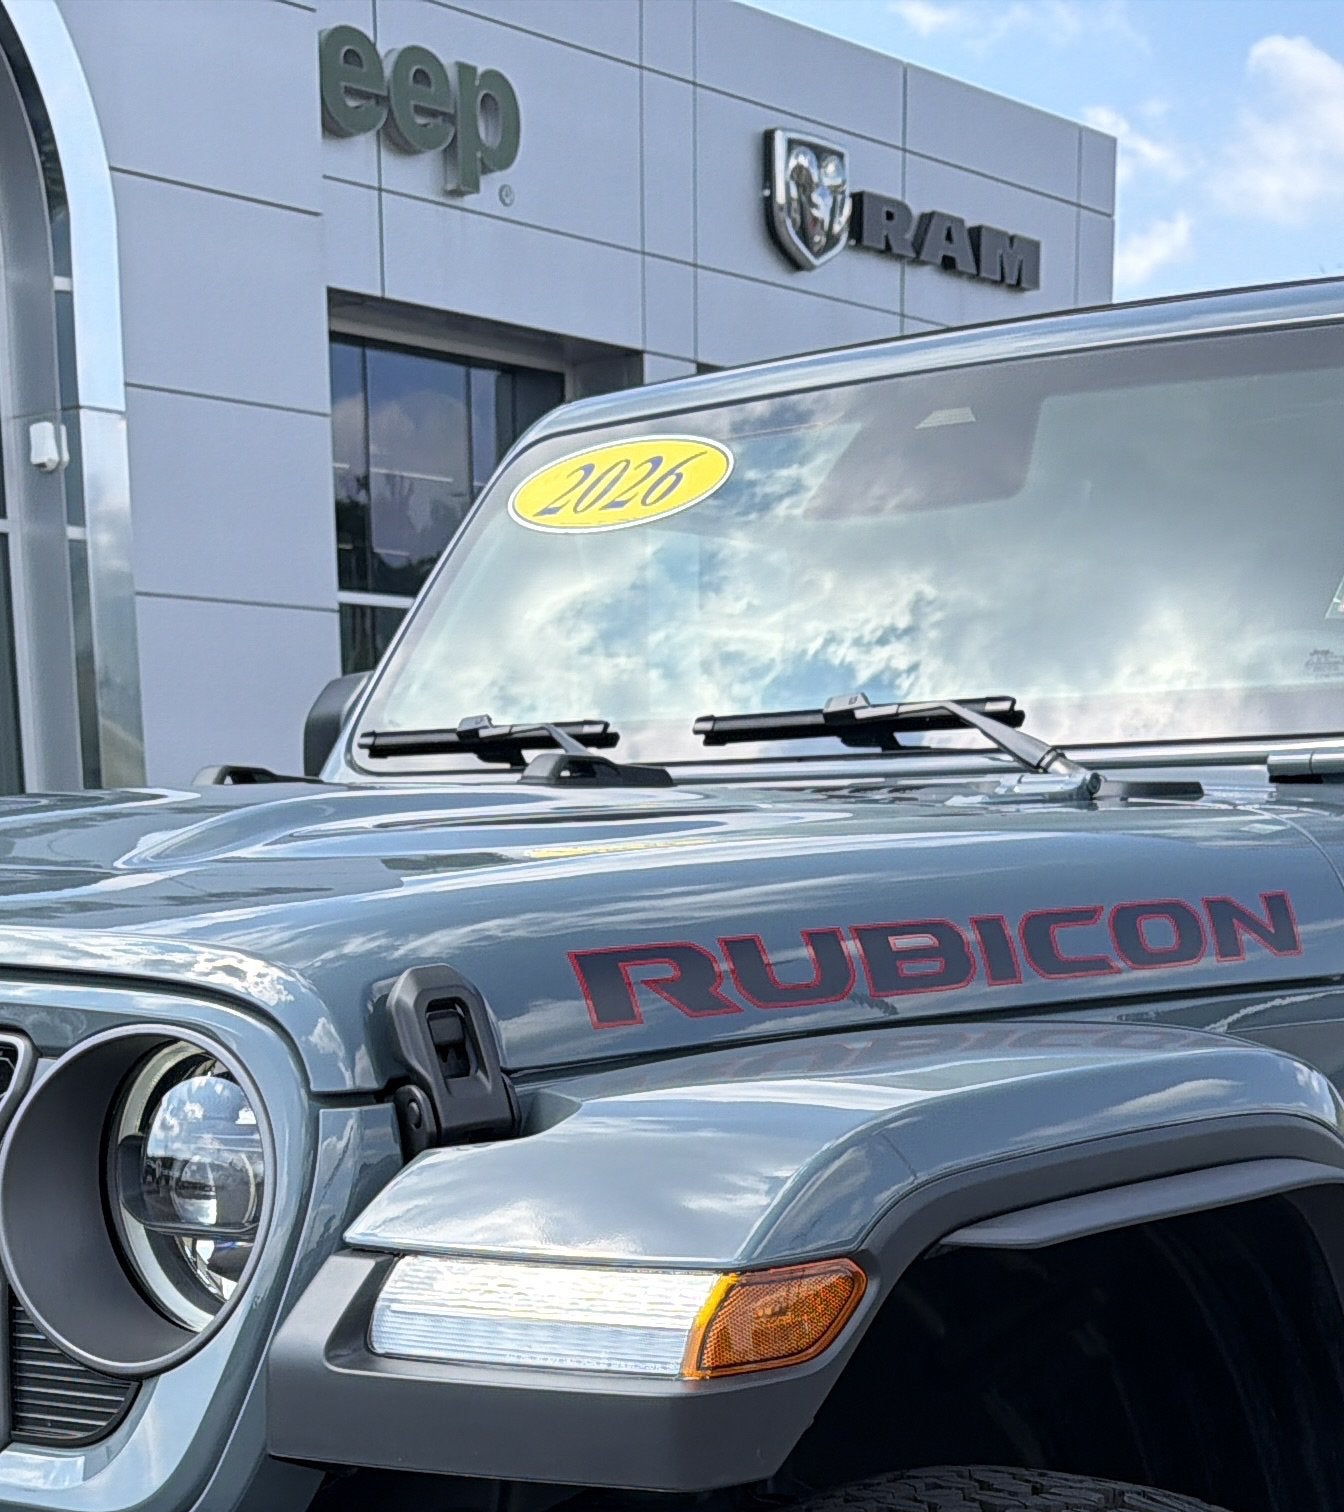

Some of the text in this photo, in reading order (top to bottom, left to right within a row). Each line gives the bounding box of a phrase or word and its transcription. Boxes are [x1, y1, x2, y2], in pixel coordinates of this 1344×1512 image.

[318, 25, 521, 197] eep
[849, 191, 1041, 292] RAM
[533, 450, 708, 518] 2026
[567, 890, 1302, 1030] RUBICON
